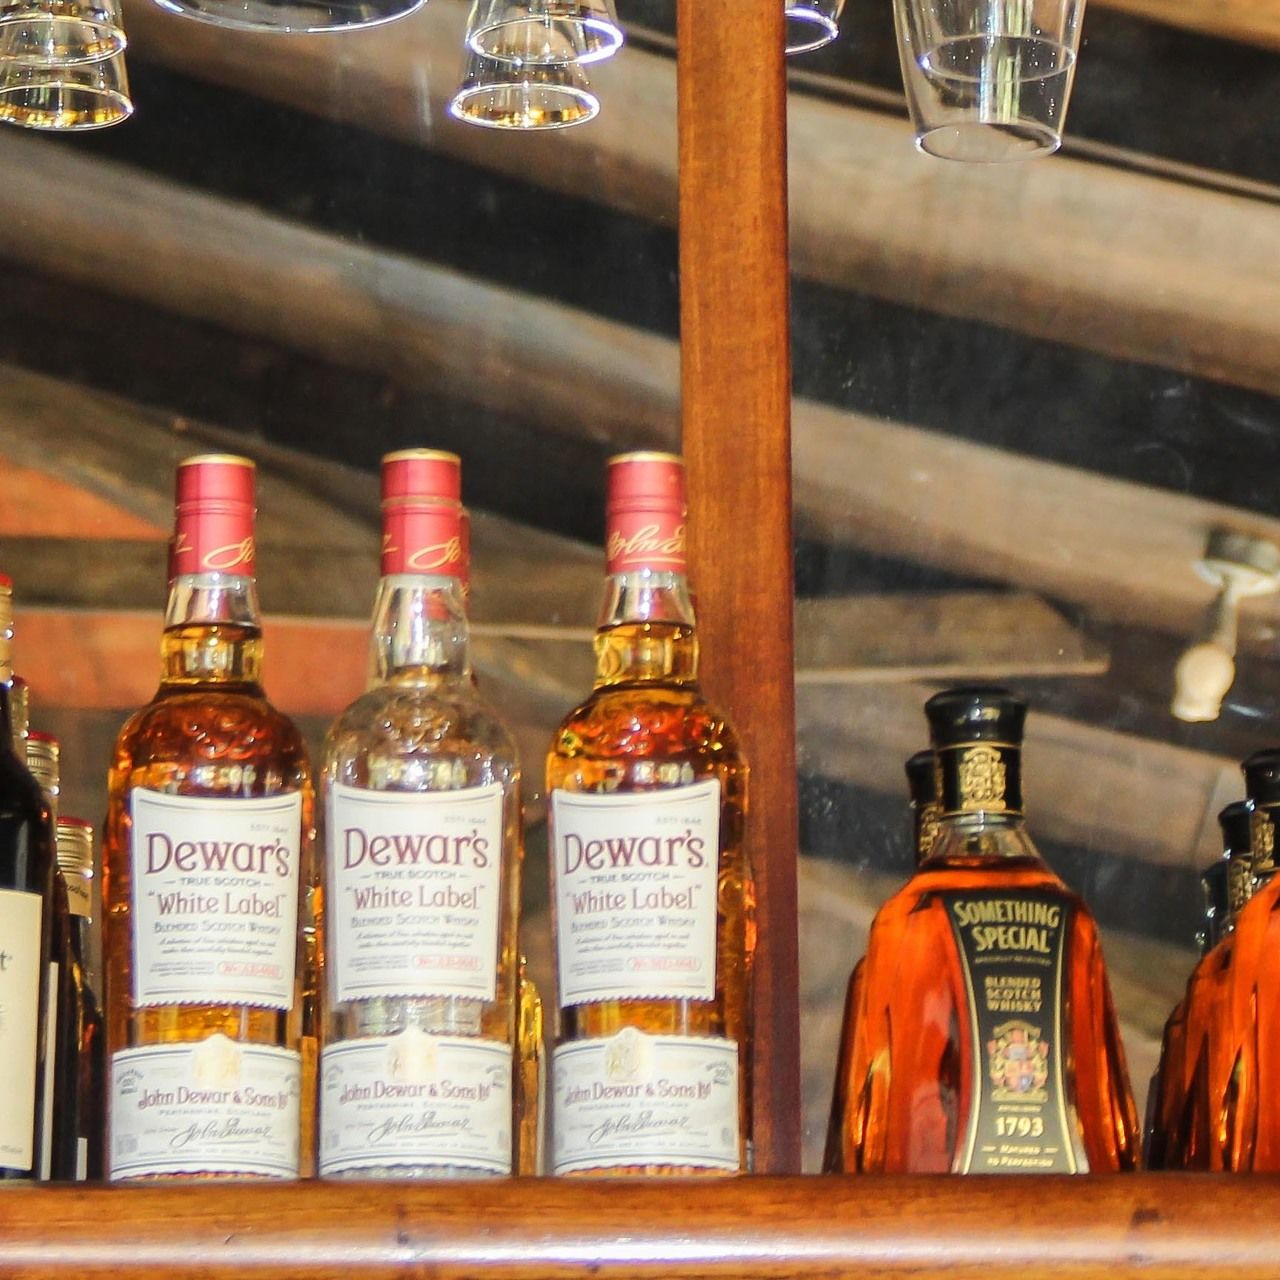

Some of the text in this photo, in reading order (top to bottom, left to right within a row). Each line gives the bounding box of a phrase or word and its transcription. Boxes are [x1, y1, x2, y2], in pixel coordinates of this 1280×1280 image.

[145, 832, 291, 878] Dewar's
[344, 827, 489, 869] Dewar's
[563, 829, 706, 875] Dewar's
[180, 877, 261, 887] TRUE SCOTCH
[374, 871, 456, 880] TRUE SCOTCH
[590, 872, 670, 884] TRUE SCOTCH
[953, 900, 1060, 928] SOMETHING
[972, 926, 1051, 953] SPECIAL
[985, 976, 1041, 987] BLENDED
[986, 989, 1041, 1000] SCOTCH
[987, 1000, 1042, 1012] WHISKY
[138, 1088, 174, 1110] John
[178, 1086, 230, 1105] Dewar
[233, 1091, 241, 1103] &
[245, 1087, 277, 1107] Sons
[339, 1083, 371, 1105] John
[374, 1080, 425, 1098] Dewar
[429, 1084, 437, 1097] &
[440, 1080, 476, 1100] Sons
[564, 1086, 592, 1105] John
[593, 1081, 640, 1100] Dewar
[645, 1084, 655, 1097] &
[657, 1079, 696, 1098] Sons
[995, 1117, 1044, 1137] 1793
